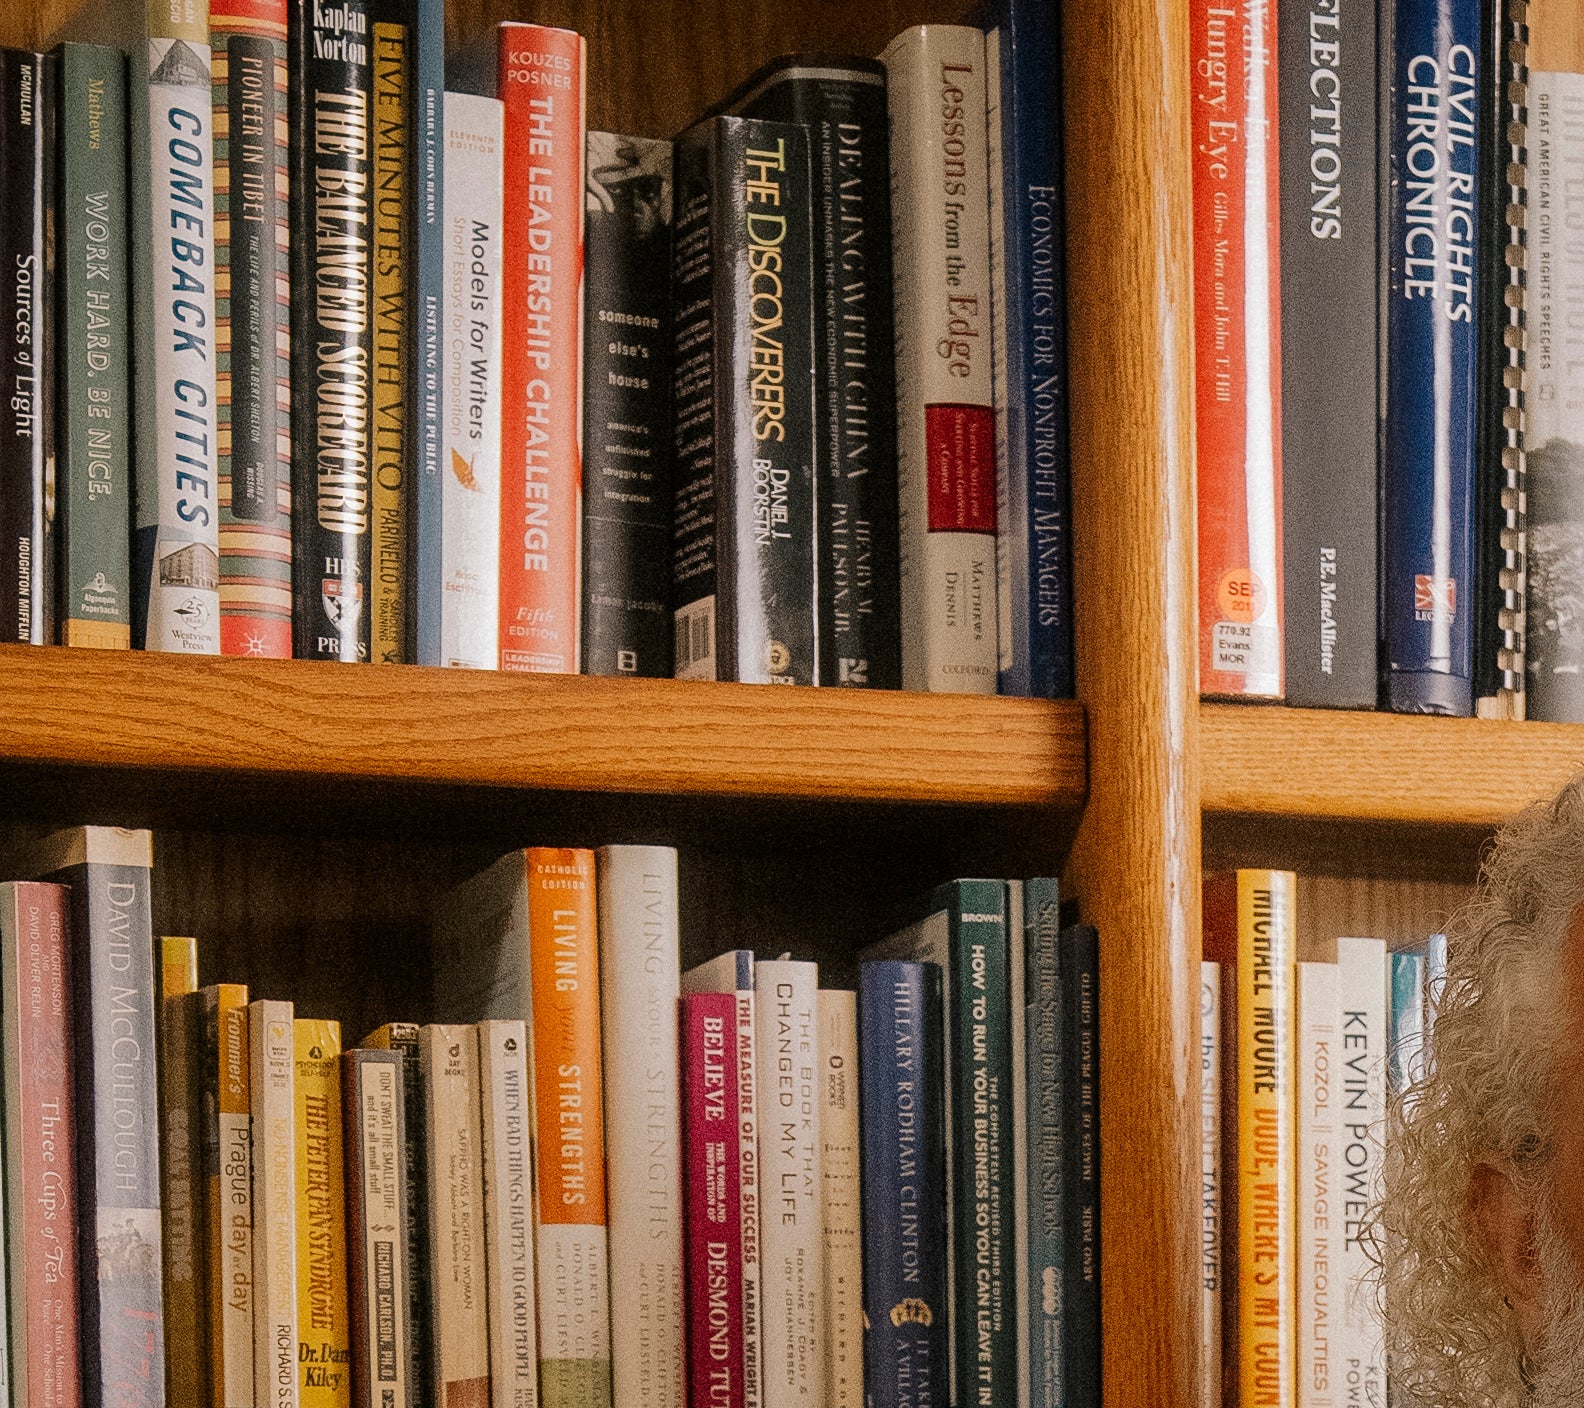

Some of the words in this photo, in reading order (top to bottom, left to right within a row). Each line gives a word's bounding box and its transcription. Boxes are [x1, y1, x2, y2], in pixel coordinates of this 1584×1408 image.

[314, 0, 366, 33] Kaplan
[314, 31, 367, 65] Norton
[242, 57, 263, 136] PIONEER
[378, 34, 403, 107] FIVE
[508, 52, 571, 70] KOUZES
[508, 69, 572, 90] POSNER
[1446, 45, 1475, 155] CIVIL
[242, 143, 264, 161] IN
[315, 87, 367, 159] THE
[530, 97, 552, 154] THE
[940, 63, 972, 195] Lessons
[242, 171, 264, 224] TIBET
[378, 122, 403, 279] MINUTES
[746, 139, 786, 206] THE
[1407, 54, 1440, 300] CHRONICLE
[85, 194, 110, 280] WORK
[168, 108, 206, 361] COMEBACK
[316, 166, 367, 331] BALANCED
[472, 220, 489, 311] Models
[945, 203, 963, 250] from
[1446, 173, 1475, 323] RIGHTS
[16, 254, 38, 346] Sources
[528, 167, 552, 371] LEADERSHIP
[949, 259, 963, 287] the
[18, 351, 33, 367] of
[86, 290, 110, 378] HARD.
[377, 293, 403, 385] WITH
[470, 323, 488, 353] for
[749, 212, 786, 443] DISCOVERERS
[938, 295, 978, 378] Edge
[12, 374, 37, 437] Light
[87, 388, 110, 420] BE
[469, 359, 488, 439] Writers
[88, 432, 112, 501] NICE.
[174, 380, 209, 527] CITIES
[317, 343, 367, 534] SCORECARD
[377, 402, 403, 491] VITO
[526, 379, 549, 570] CHALLENGE
[509, 625, 558, 640] EDITION
[517, 607, 556, 623] Fifth
[106, 883, 135, 971] DAVID
[553, 909, 578, 992] LIVING
[961, 912, 1001, 923] BROWN
[228, 1009, 244, 1094] Frommer's
[776, 983, 794, 1107] CHANGED
[800, 1010, 811, 1052] THE
[894, 982, 915, 1067] HILLARY
[1344, 1012, 1367, 1110] KEVIN
[703, 1016, 725, 1122] BELIEVE
[801, 1067, 812, 1129] BOOK
[1314, 1041, 1328, 1117] KOZOL
[42, 1098, 60, 1161] Three
[226, 1128, 249, 1205] Prague
[559, 1064, 585, 1206] STRENGTHS
[780, 1123, 796, 1158] MY
[897, 1081, 916, 1177] RODHAM
[39, 1172, 67, 1221] Cups
[781, 1174, 797, 1226] LIFE
[803, 1145, 813, 1199] THAT
[1314, 1145, 1327, 1229] SAVAGE
[1344, 1124, 1368, 1251] POWELL
[42, 1228, 56, 1239] of
[45, 1246, 65, 1284] Tea
[228, 1215, 246, 1256] day
[900, 1186, 920, 1283] CLINTON
[229, 1273, 251, 1312] day
[707, 1242, 729, 1361] DESMOND
[1313, 1237, 1328, 1391] INEQUALITIES
[299, 1343, 319, 1363] Dr.
[305, 1367, 341, 1391] Kiley
